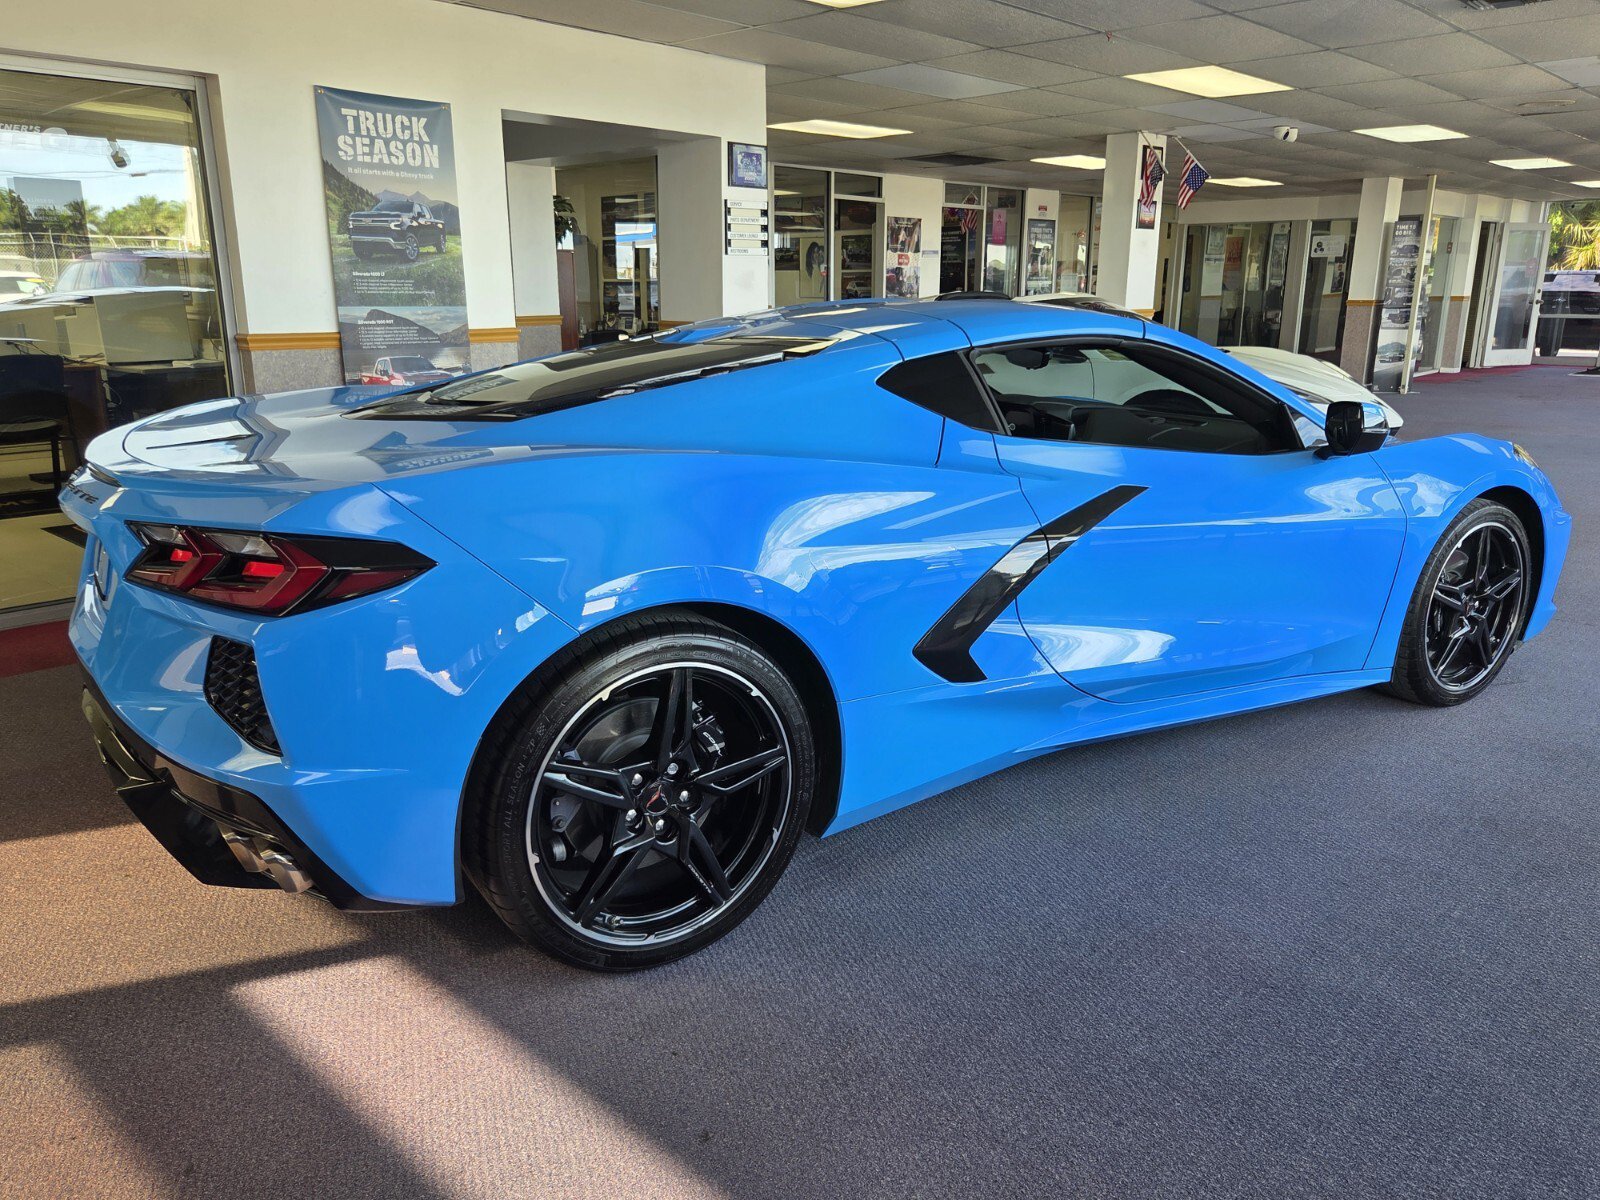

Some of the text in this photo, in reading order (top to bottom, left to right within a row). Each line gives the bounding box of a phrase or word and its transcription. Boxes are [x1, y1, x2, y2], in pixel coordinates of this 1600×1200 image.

[340, 107, 431, 143] TRUCK
[337, 134, 440, 169] SEASON
[362, 168, 381, 176] starts
[381, 169, 395, 177] with
[400, 171, 418, 180] Chevy
[525, 738, 536, 755] ZP
[507, 762, 526, 808] SEASON
[504, 810, 514, 829] ALL
